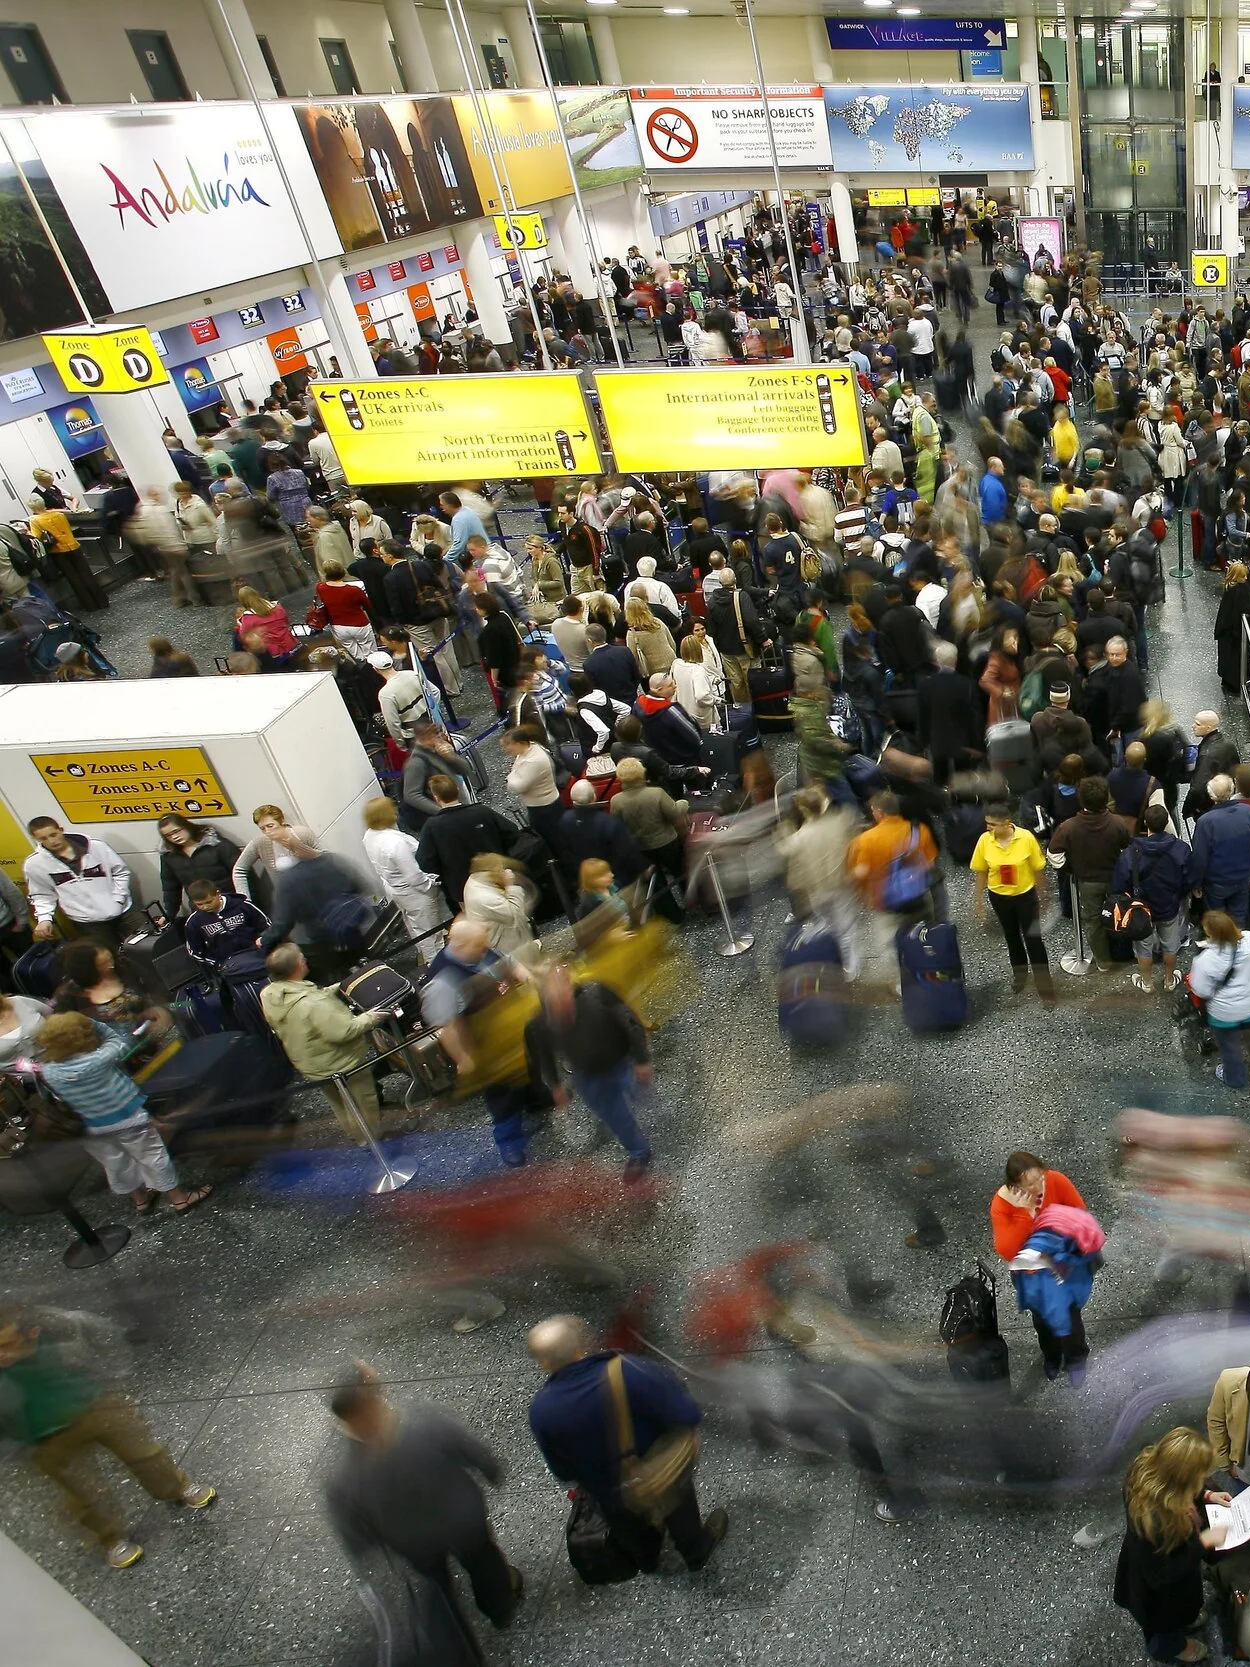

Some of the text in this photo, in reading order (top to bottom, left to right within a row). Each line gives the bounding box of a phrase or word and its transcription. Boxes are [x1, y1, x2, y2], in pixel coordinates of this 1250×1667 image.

[673, 86, 811, 97] Important Security Iformation
[942, 88, 952, 96] Fly
[966, 88, 1000, 96] everything
[1013, 88, 1025, 96] buy
[711, 108, 815, 119] NO SHARP OBJECTS
[518, 122, 545, 149] loves
[545, 128, 562, 150] you
[234, 151, 274, 166] loves you
[1205, 268, 1217, 280] E
[284, 295, 302, 311] 32
[240, 308, 260, 324] 32
[59, 340, 90, 351] Zone
[113, 335, 141, 347] Zone
[70, 357, 101, 383] D
[124, 353, 149, 379] D
[184, 376, 206, 389] Thomas
[748, 375, 813, 388] Zones F-S
[358, 387, 429, 401] Zones A-C
[666, 390, 815, 404] International arrivals
[362, 402, 445, 415] UK arrivals
[753, 404, 817, 415] Left baggage
[66, 417, 93, 431] Thomas
[369, 417, 404, 428] Toilets
[717, 413, 819, 426] Baggage forwarding
[728, 424, 820, 435] Conference Centre
[444, 431, 552, 446] North Terminal
[416, 446, 556, 464] Airport information
[515, 459, 560, 471] Trains
[786, 551, 795, 564] 4
[87, 759, 170, 775] Zones A-C
[89, 780, 172, 795] Zones D-E
[101, 800, 183, 815] Zones F-K
